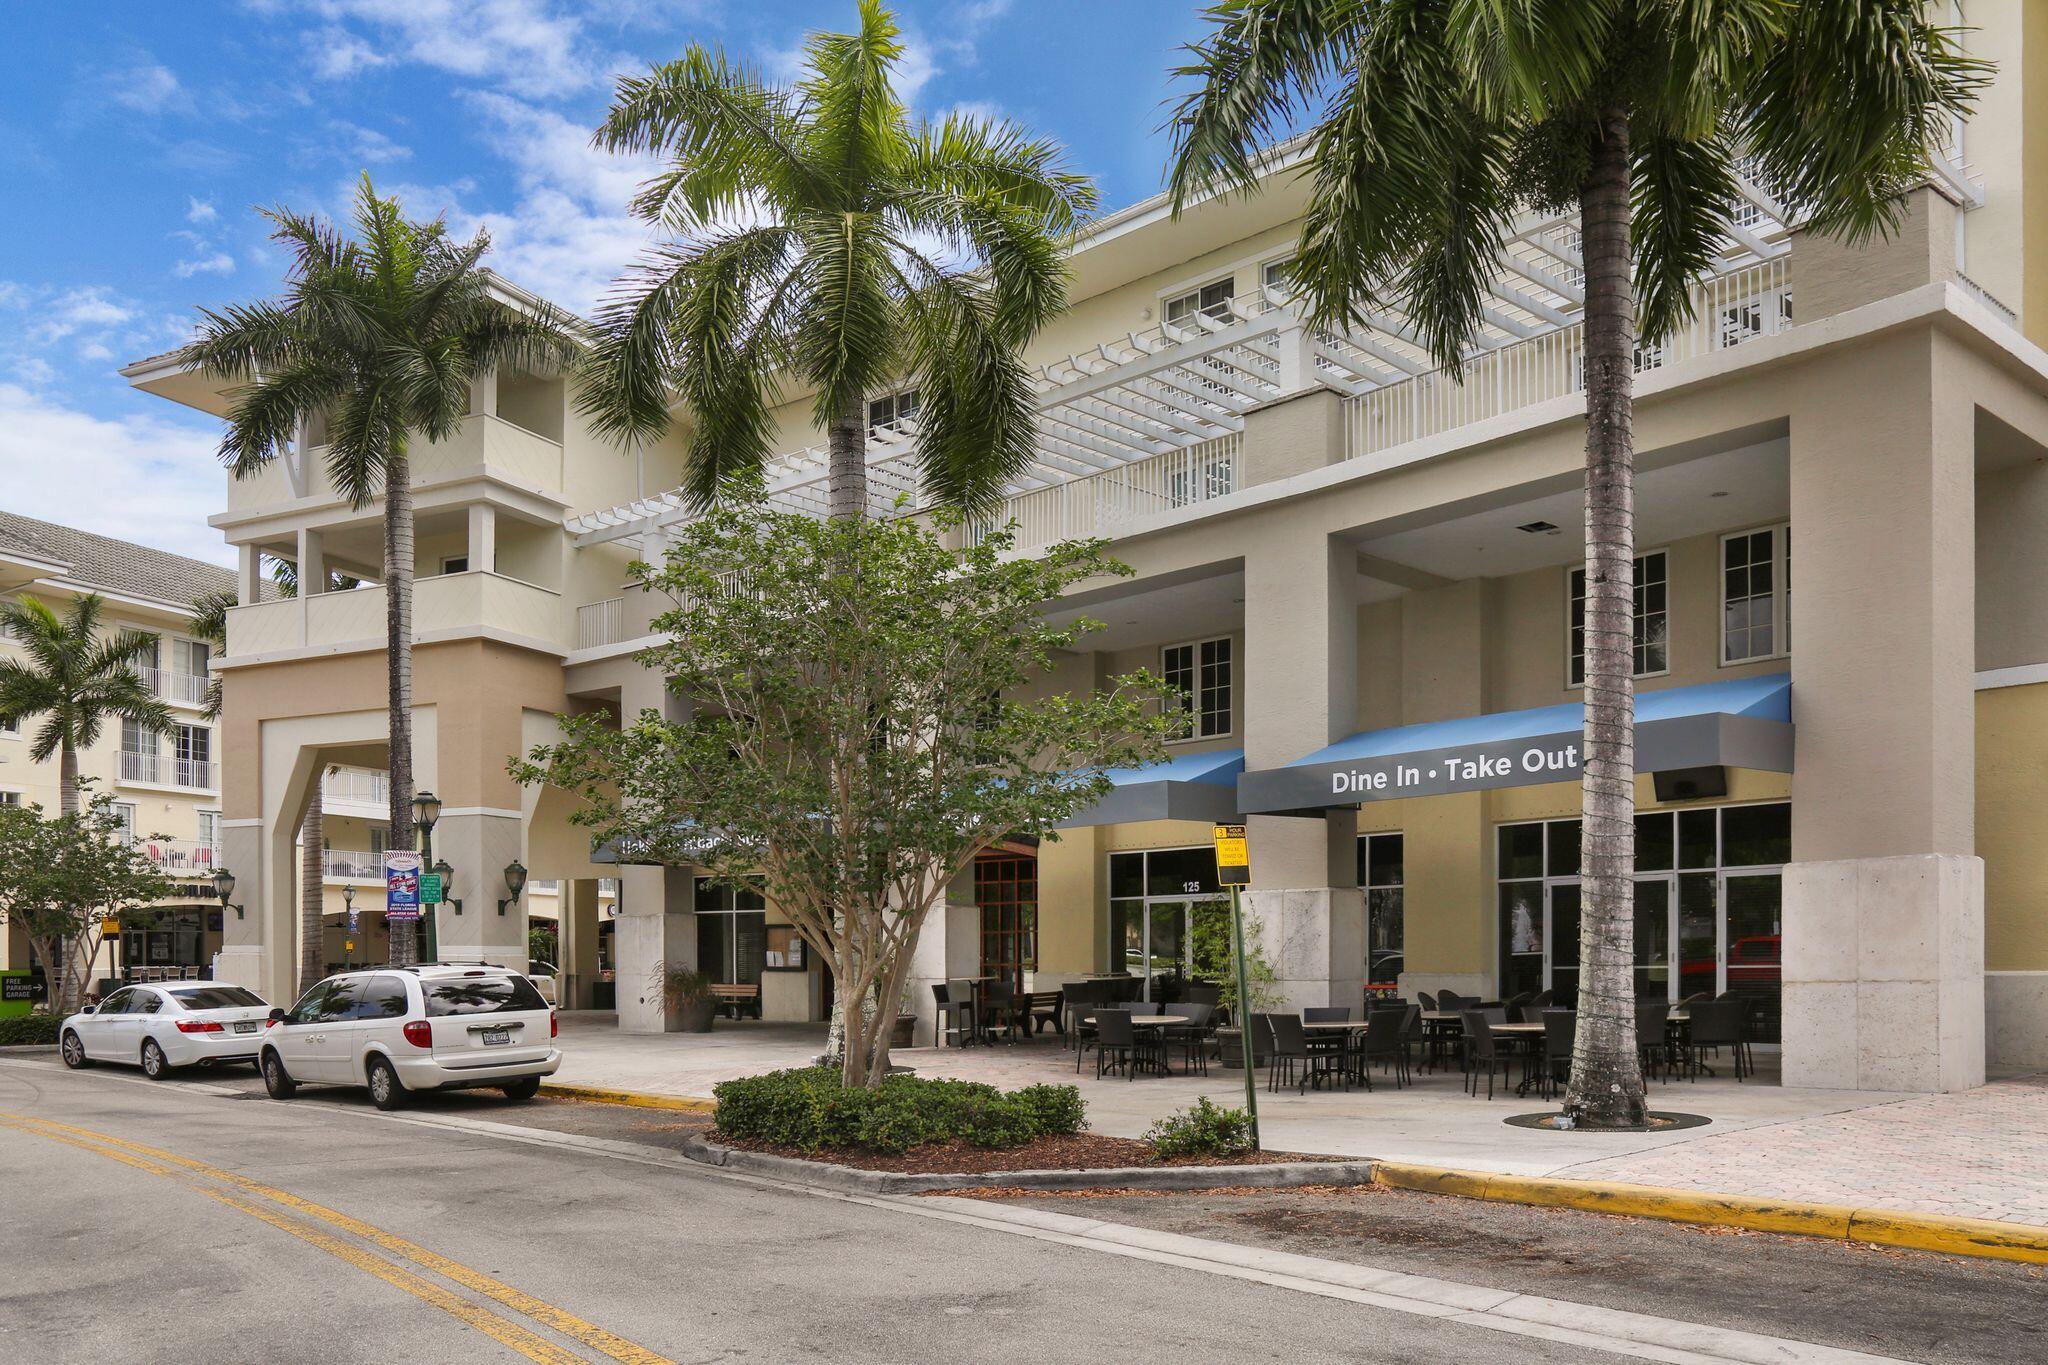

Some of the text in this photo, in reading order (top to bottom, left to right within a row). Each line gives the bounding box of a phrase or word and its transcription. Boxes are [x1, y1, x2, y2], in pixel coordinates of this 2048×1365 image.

[1332, 745, 1577, 794] Dine In Take Out
[1183, 881, 1200, 893] 125
